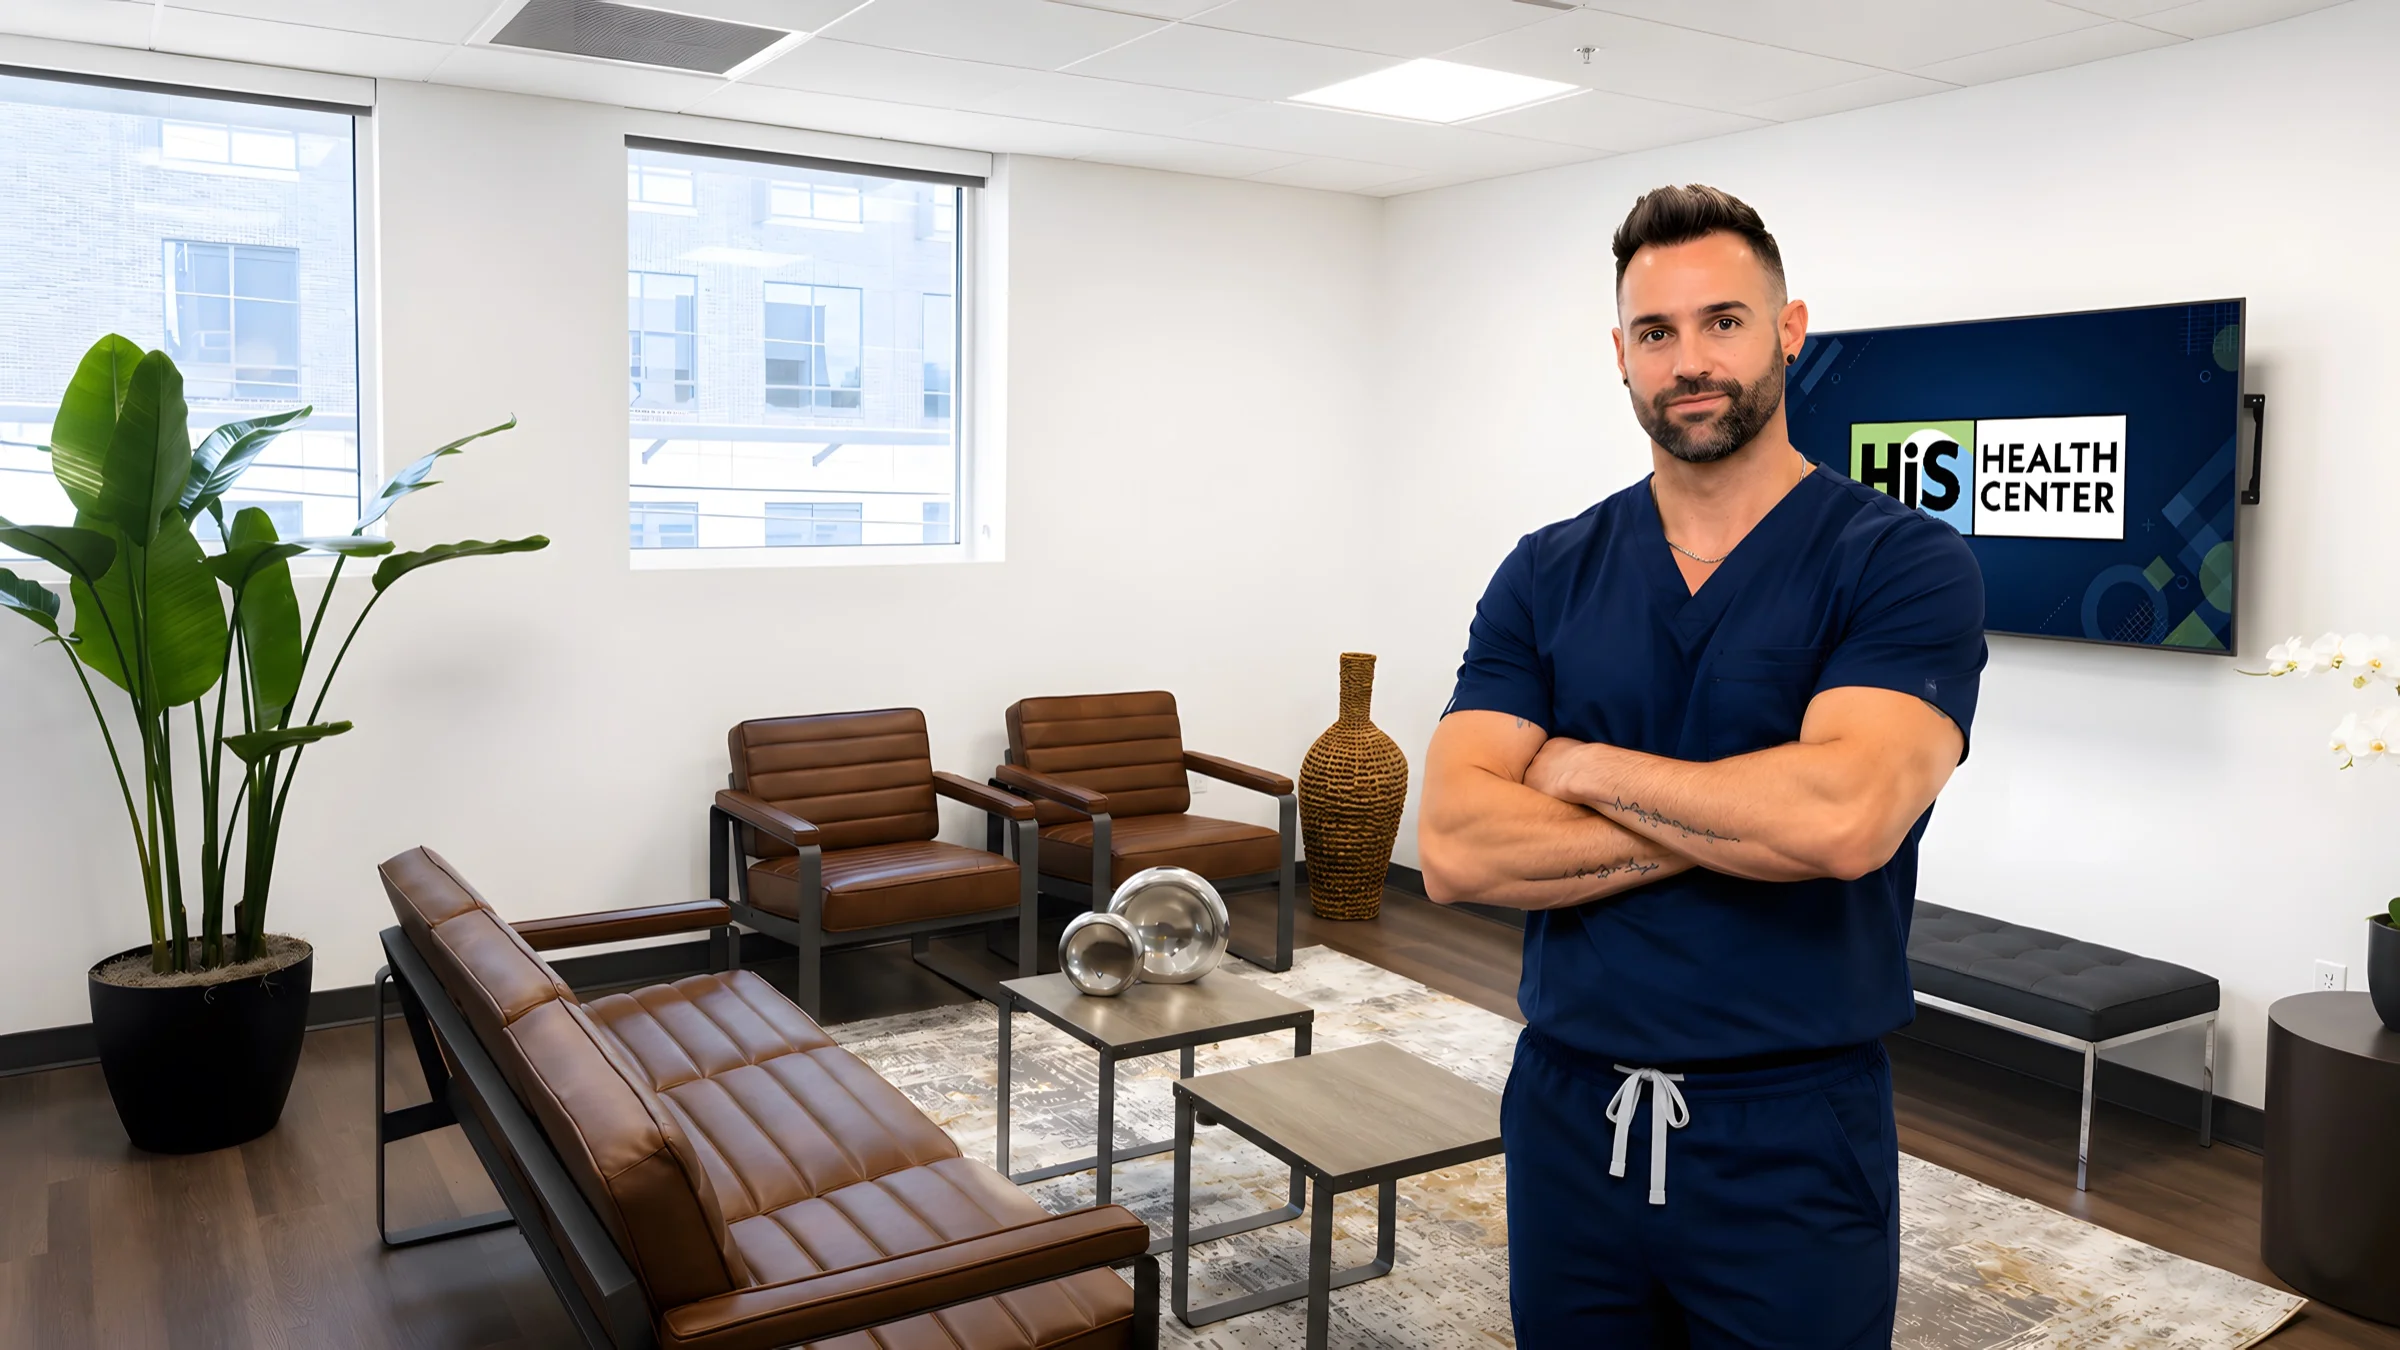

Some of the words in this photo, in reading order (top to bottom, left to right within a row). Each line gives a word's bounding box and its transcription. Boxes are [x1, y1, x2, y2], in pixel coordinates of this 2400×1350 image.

[1982, 441, 2118, 474] HEALTH
[1861, 440, 1961, 512] HiS
[1980, 480, 2115, 514] CENTER
